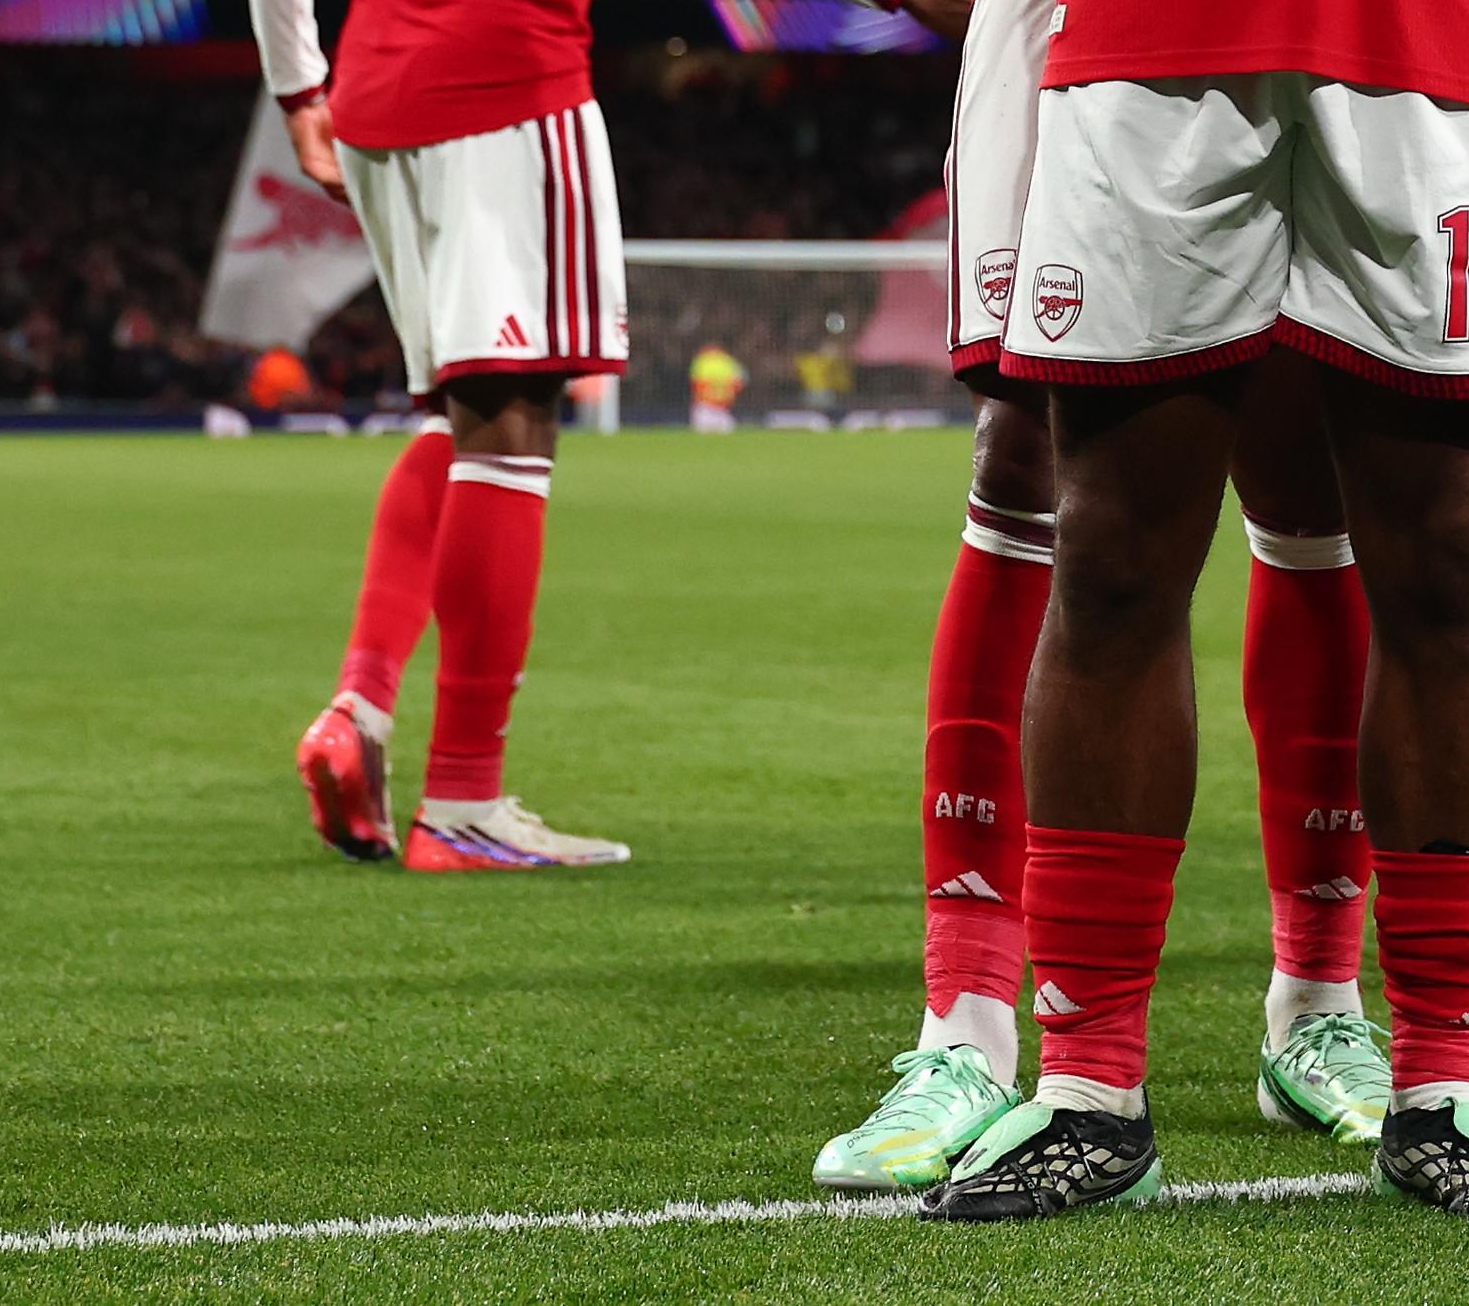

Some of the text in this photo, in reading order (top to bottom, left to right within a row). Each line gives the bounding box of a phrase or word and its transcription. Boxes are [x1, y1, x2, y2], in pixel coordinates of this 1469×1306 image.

[1039, 277, 1075, 292] Arsenal
[935, 792, 996, 824] AFC
[1305, 808, 1364, 831] AFC
